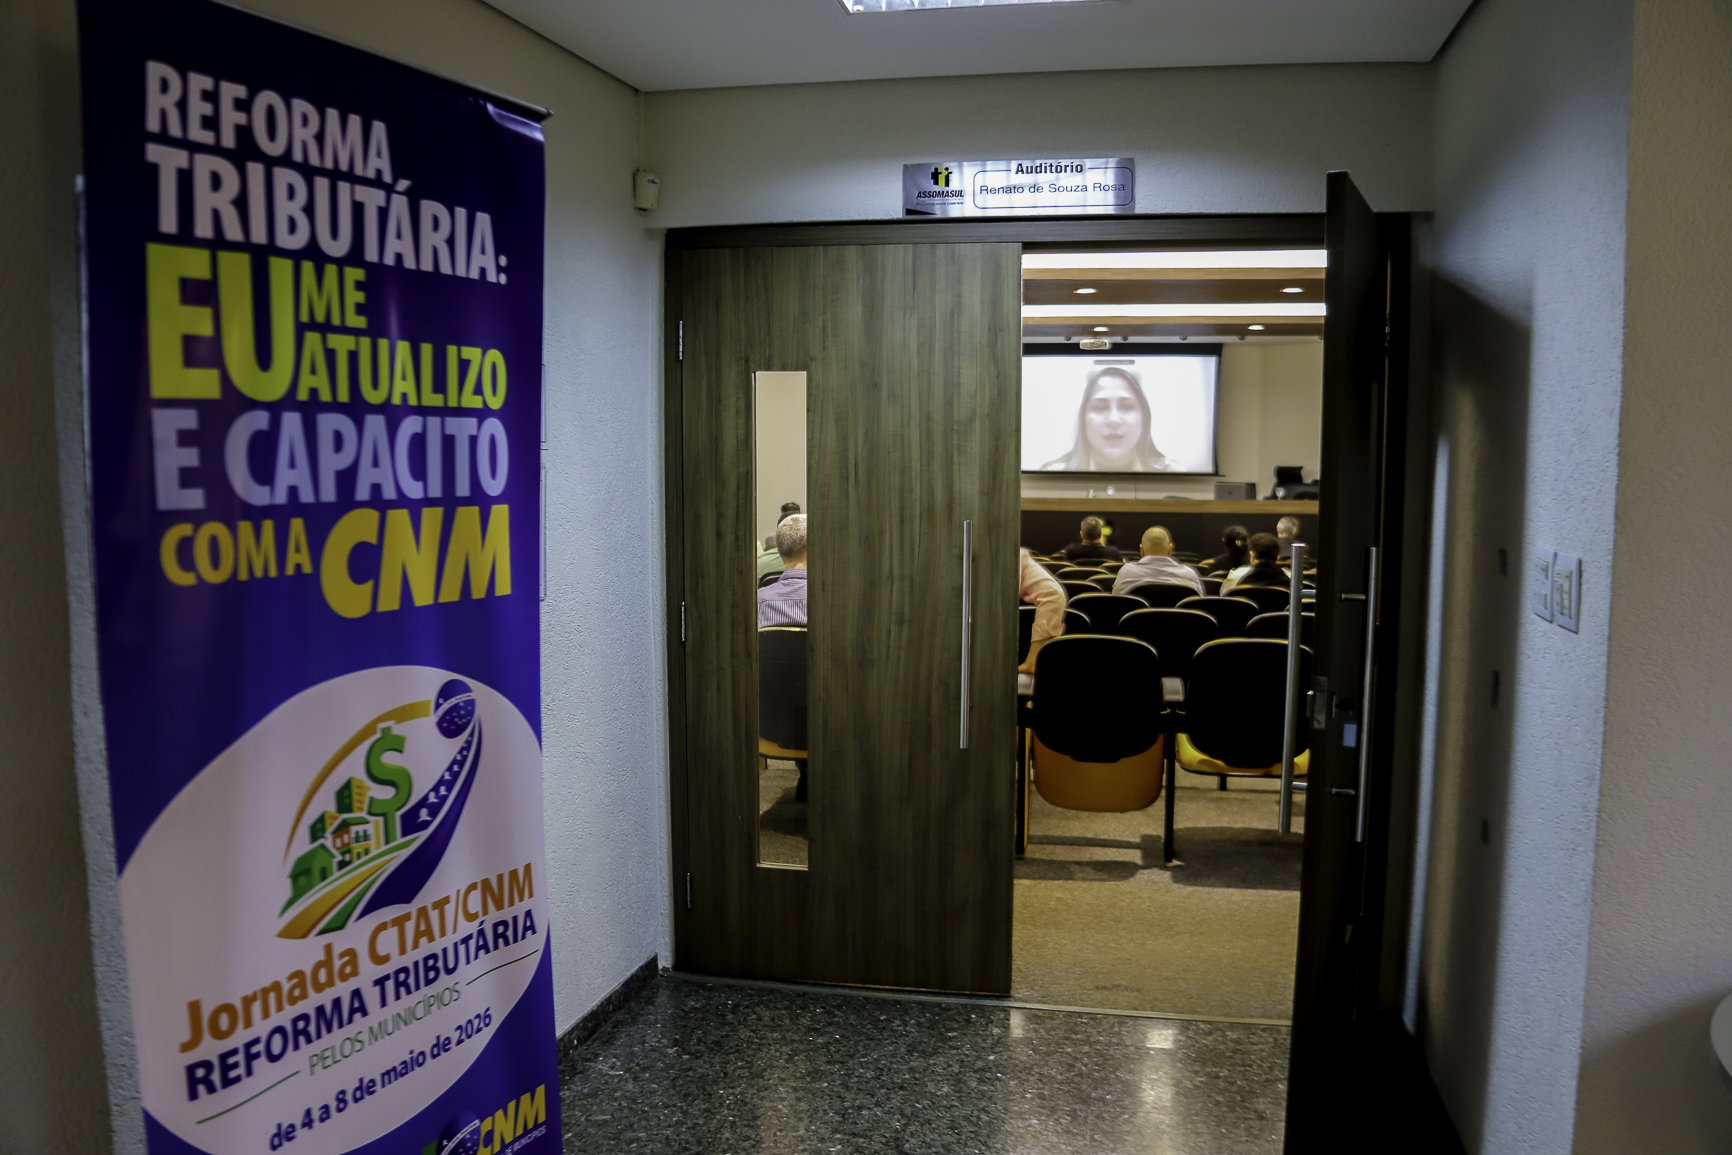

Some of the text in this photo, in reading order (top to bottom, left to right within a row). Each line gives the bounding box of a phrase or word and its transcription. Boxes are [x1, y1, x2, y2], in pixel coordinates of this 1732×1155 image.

[144, 59, 393, 184] REFORMA
[1014, 161, 1084, 175] Auditório
[144, 142, 508, 285] TRIBUTÁRIA:
[916, 189, 965, 199] ASSOMASUL
[979, 181, 1126, 195] Renato de Souza Rosa
[144, 242, 368, 402] EU ME
[295, 331, 508, 411] ATUALIZO
[150, 408, 509, 511] E CAPACITO
[159, 504, 513, 619] COM A CNM
[178, 862, 534, 1053] Jornada CTAT/CNM
[184, 908, 538, 1102] REFORMA TRIBUTÁRIA
[269, 1006, 493, 1152] de 4 a 8 de maio de 2026
[308, 982, 462, 1076] PELOS MUNICÍPIOS
[476, 1083, 547, 1155] CNM
